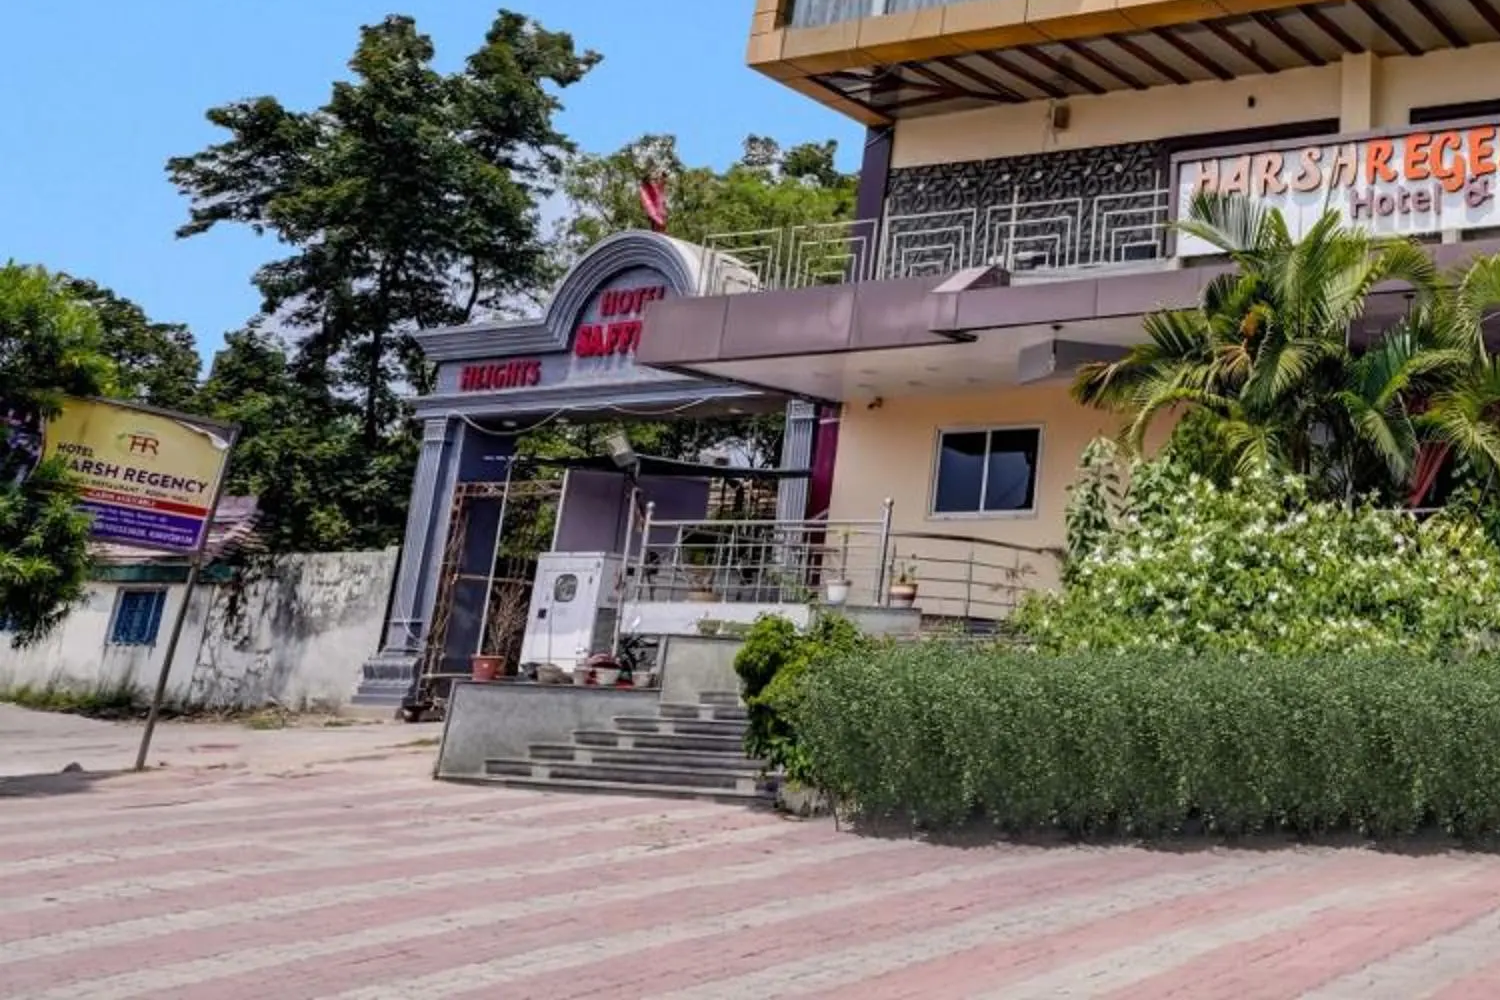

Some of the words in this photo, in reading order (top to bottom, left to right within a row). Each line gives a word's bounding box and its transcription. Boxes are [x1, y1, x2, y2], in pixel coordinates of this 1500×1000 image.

[1193, 144, 1358, 196] HARSH
[1350, 183, 1442, 219] Hotel
[1464, 174, 1495, 207] &
[460, 360, 542, 392] HEIGHTS
[57, 441, 94, 457] HOTEL
[62, 457, 119, 478] ARSH
[123, 467, 208, 495] REGENCY
